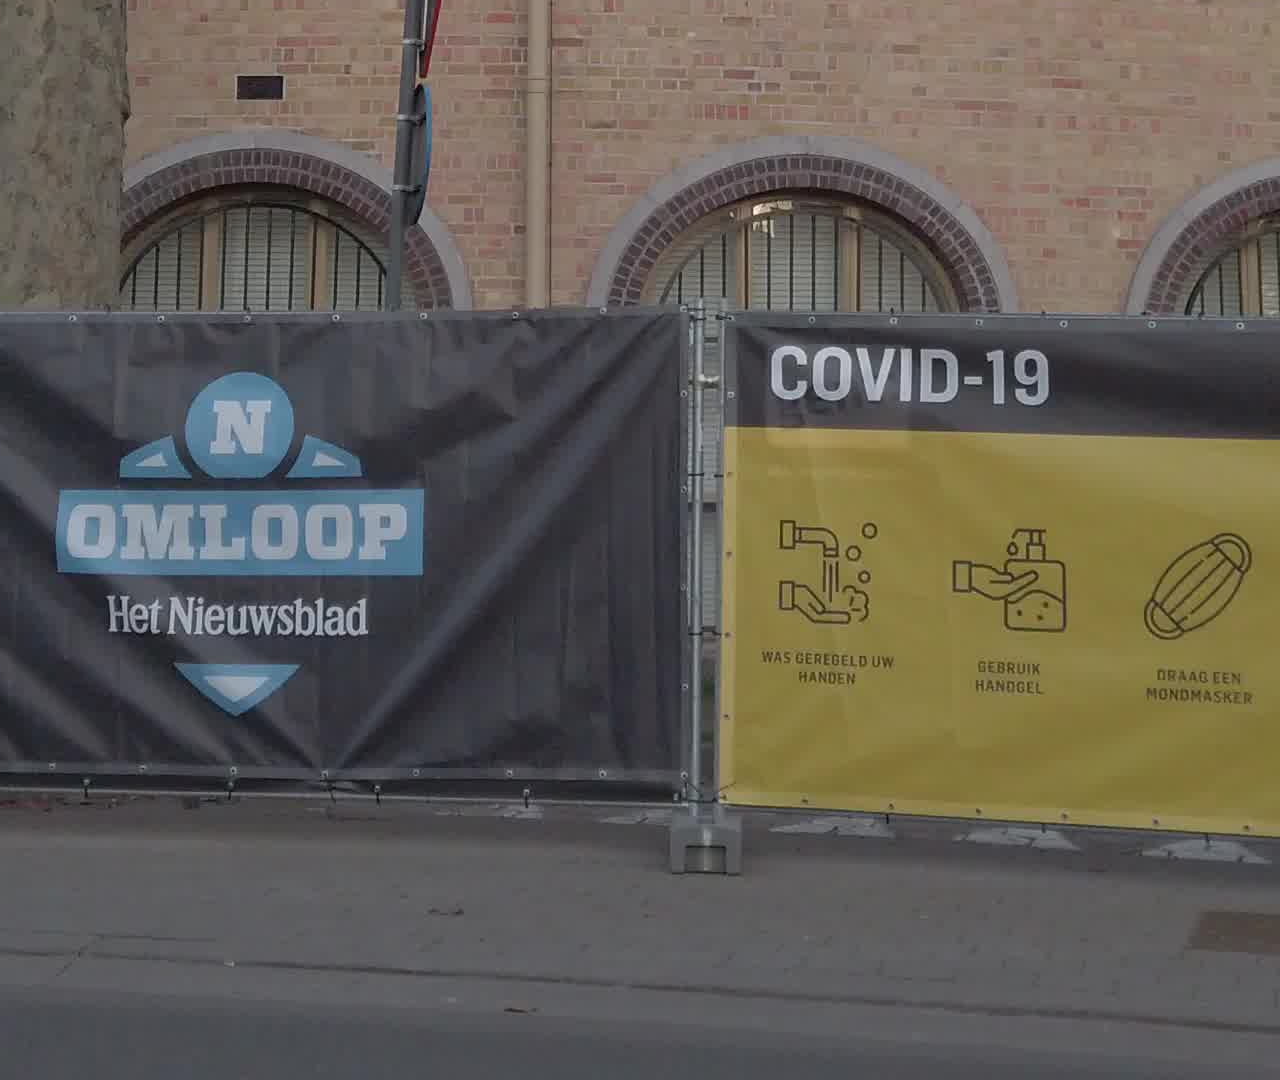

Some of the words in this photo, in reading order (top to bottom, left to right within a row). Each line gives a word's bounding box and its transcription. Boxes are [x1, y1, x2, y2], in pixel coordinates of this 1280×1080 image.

[770, 346, 1050, 406] COVID-19
[209, 400, 272, 454] N
[66, 503, 408, 560] OMLOOP
[106, 595, 162, 635] Het
[166, 596, 369, 636] Nieuwsblad
[761, 650, 792, 666] WAS
[794, 651, 869, 668] GEREGELD
[870, 654, 895, 669] UW
[977, 660, 1041, 677] GEBRUIK
[798, 670, 857, 686] HANDEN
[1156, 669, 1210, 685] DRAAG
[1213, 672, 1241, 686] EEN
[975, 679, 1044, 696] HANDGEL
[1146, 687, 1254, 706] MONDMASKER
